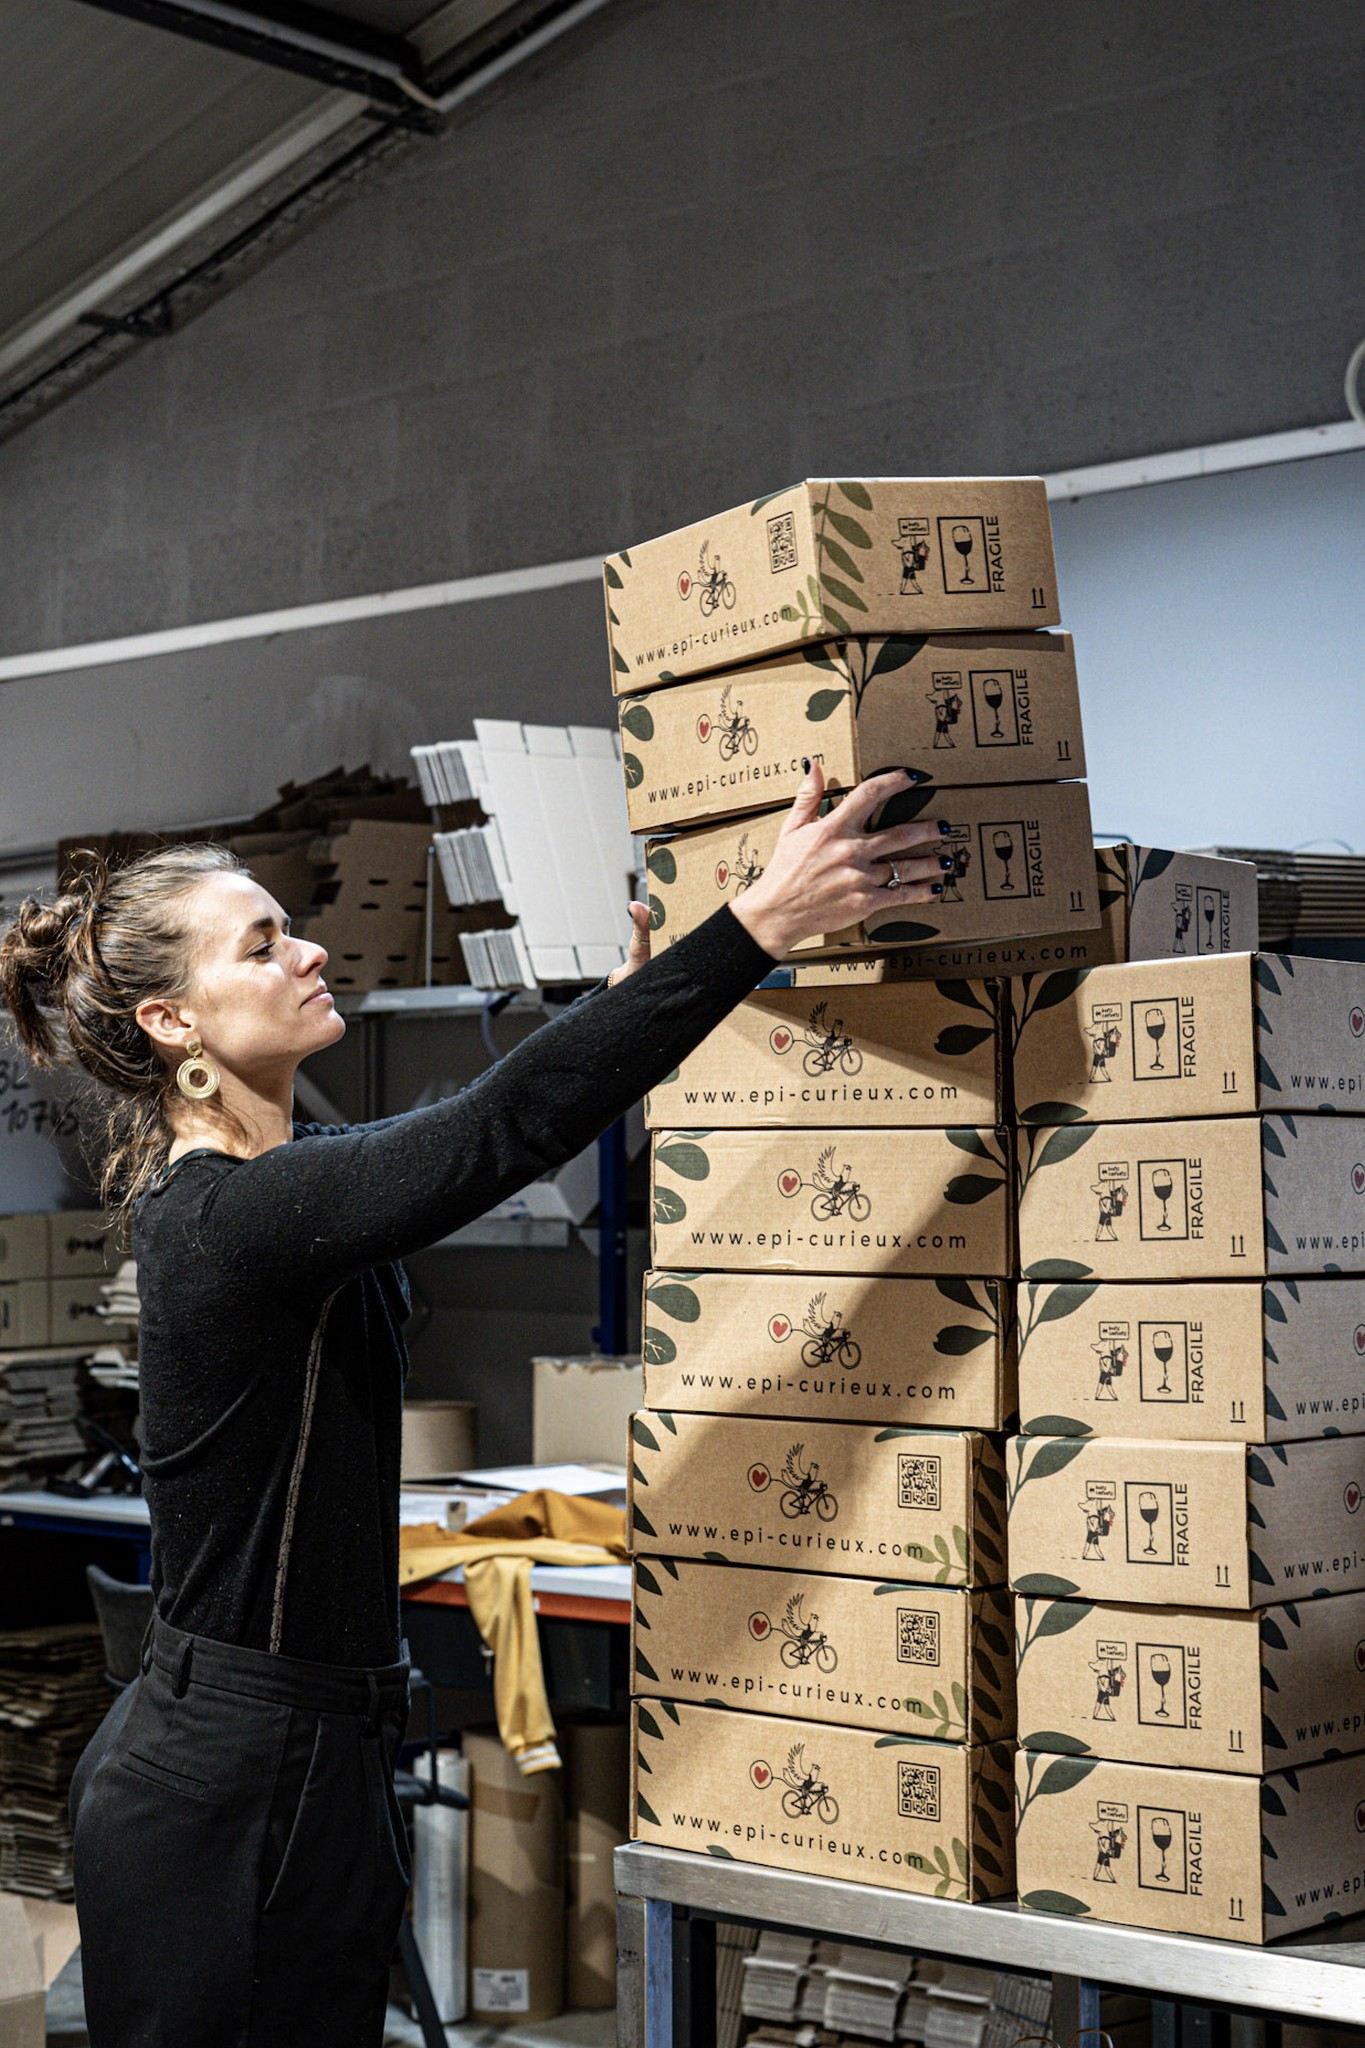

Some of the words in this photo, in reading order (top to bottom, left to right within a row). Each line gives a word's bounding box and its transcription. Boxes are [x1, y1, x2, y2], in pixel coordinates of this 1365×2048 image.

[986, 515, 1006, 593] FRAGILE
[636, 605, 793, 665] www.epi-curieux.com
[1015, 668, 1034, 745] FRAGILE
[1027, 819, 1046, 897] FRAGILE
[1223, 890, 1231, 952] RAGILE
[1181, 995, 1196, 1078] FRAGILE
[684, 1084, 958, 1106] www.epi-curieux.com
[1291, 1075, 1362, 1094] www.epi
[1189, 1157, 1204, 1240] FRAGILE
[691, 1229, 967, 1249] www.epi-curieux.com
[681, 1374, 955, 1400] www.epi-curieux.com
[1190, 1321, 1204, 1404] FRAGILE
[669, 1523, 924, 1559] www.epi-curieux.com
[1174, 1482, 1190, 1566] FRAGILE
[671, 1668, 922, 1714] www.epi-curieux.com
[1187, 1646, 1203, 1730] FRAGILE
[673, 1814, 924, 1869] www.epi-curieux.com
[1188, 1811, 1204, 1896] FRAGILE
